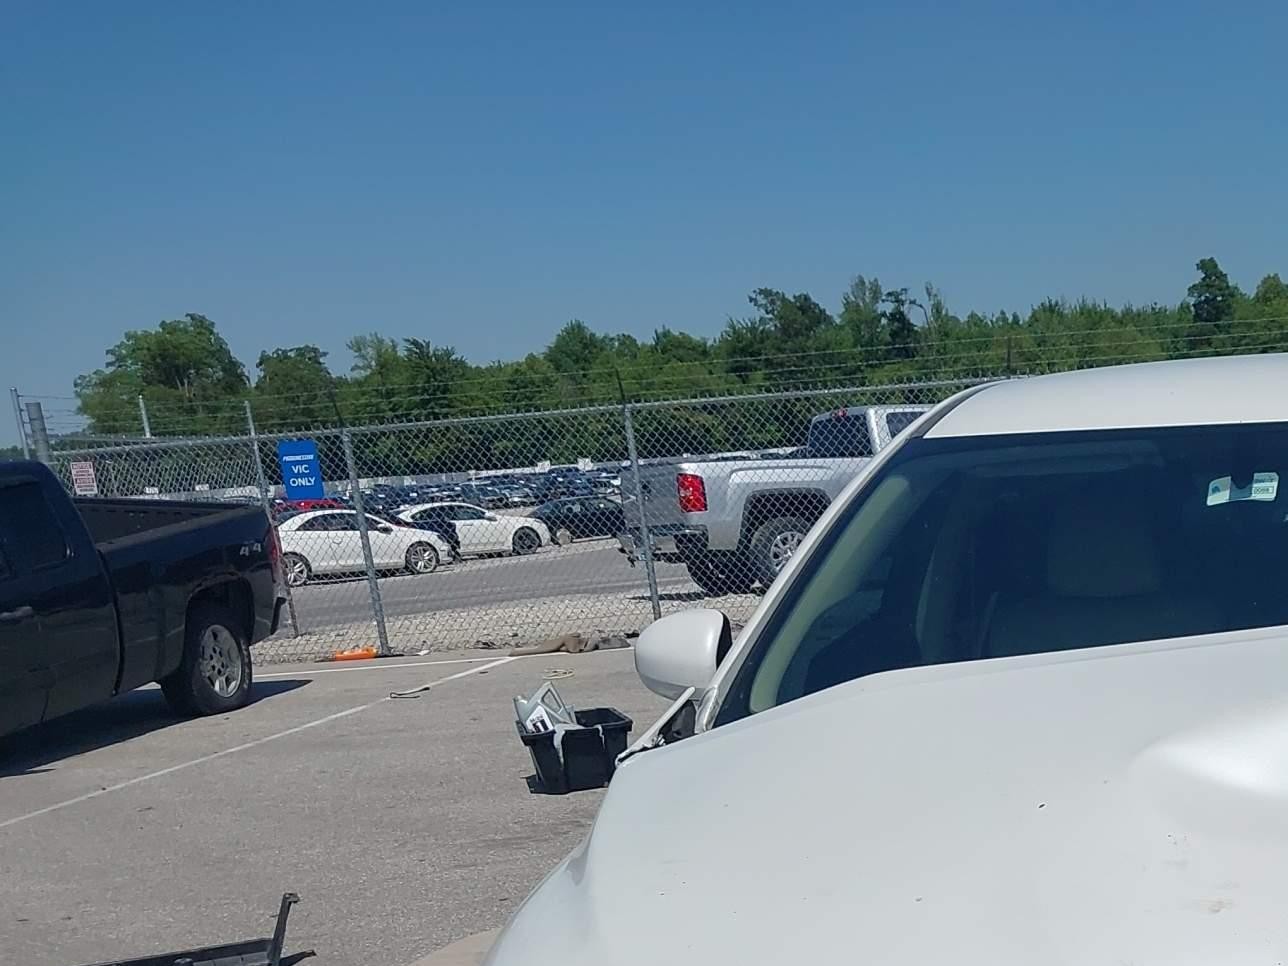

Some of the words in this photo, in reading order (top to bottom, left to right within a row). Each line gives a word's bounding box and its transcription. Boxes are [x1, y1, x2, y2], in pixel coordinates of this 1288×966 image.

[291, 464, 310, 474] VIC
[289, 476, 315, 487] ONLY
[239, 542, 262, 556] 44
